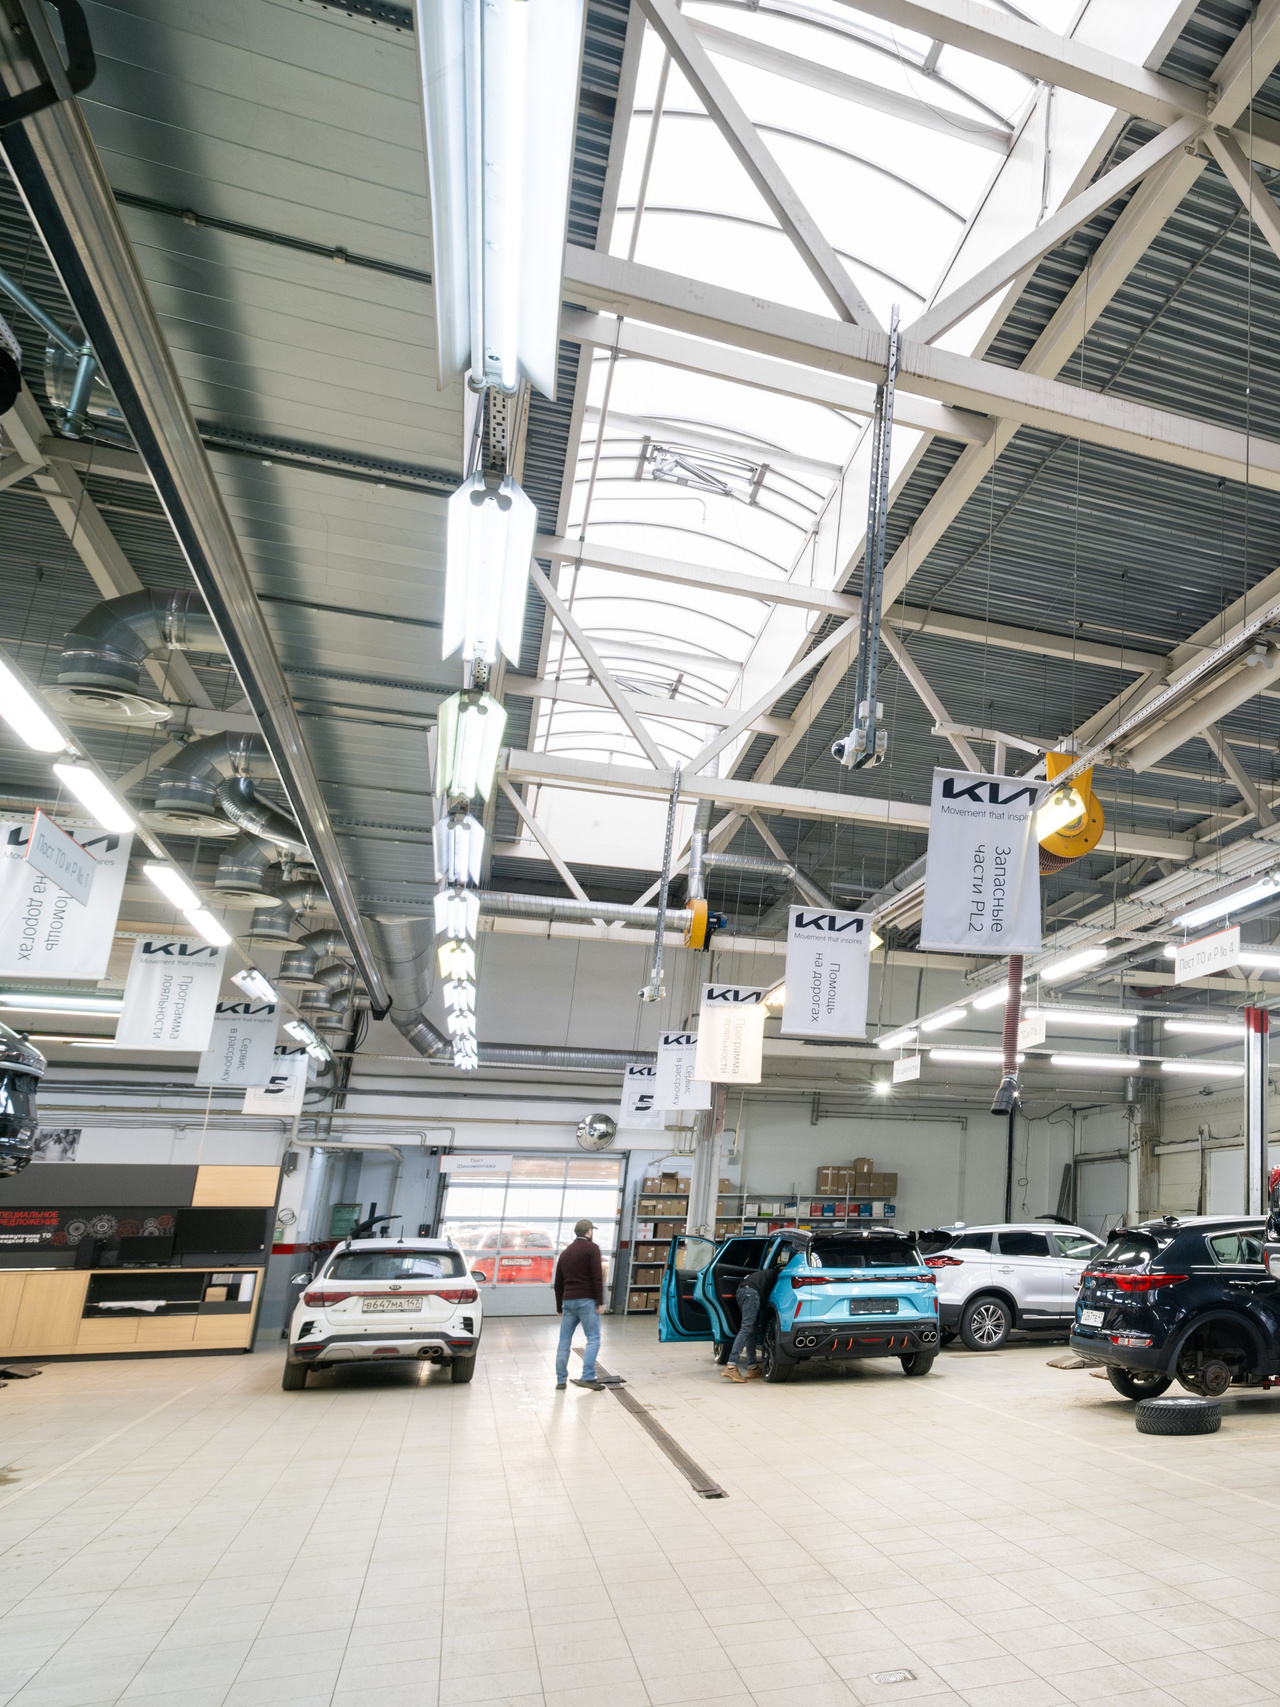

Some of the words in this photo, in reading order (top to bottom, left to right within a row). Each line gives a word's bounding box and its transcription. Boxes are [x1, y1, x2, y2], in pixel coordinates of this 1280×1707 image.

[942, 777, 1039, 806] KIA
[941, 805, 987, 818] Movement
[988, 810, 1005, 820] that
[1007, 811, 1031, 823] inspir
[37, 833, 55, 859] Пост
[57, 848, 66, 868] ТО
[66, 864, 70, 874] и
[33, 875, 48, 894] на
[971, 844, 986, 895] части
[991, 846, 1012, 933] Запасные
[17, 897, 43, 961] дорогах
[795, 912, 864, 933] KIA
[968, 900, 985, 932] PL2
[142, 941, 220, 958] KIA
[794, 932, 826, 942] Movement
[841, 937, 863, 945] inspires
[140, 958, 175, 966] Movement
[814, 952, 823, 967] на
[1180, 957, 1194, 971] Пост
[1196, 951, 1206, 965] ТО
[1207, 952, 1212, 962] и
[1229, 941, 1234, 954] 4
[707, 988, 762, 1002] KIA
[811, 971, 822, 1022] дорогах
[826, 962, 840, 1014] Помощь
[152, 974, 173, 1039] лояльности
[170, 975, 194, 1039] Программа
[215, 1002, 275, 1015] KIA
[220, 1036, 237, 1082] рассрочку
[237, 1037, 252, 1071] Сервис
[720, 1018, 731, 1074] лояльности
[732, 1018, 745, 1074] Программа
[264, 1076, 288, 1094] 5
[672, 1064, 682, 1105] рассрочку
[635, 1095, 654, 1111] 5
[366, 1300, 404, 1310] В647МА
